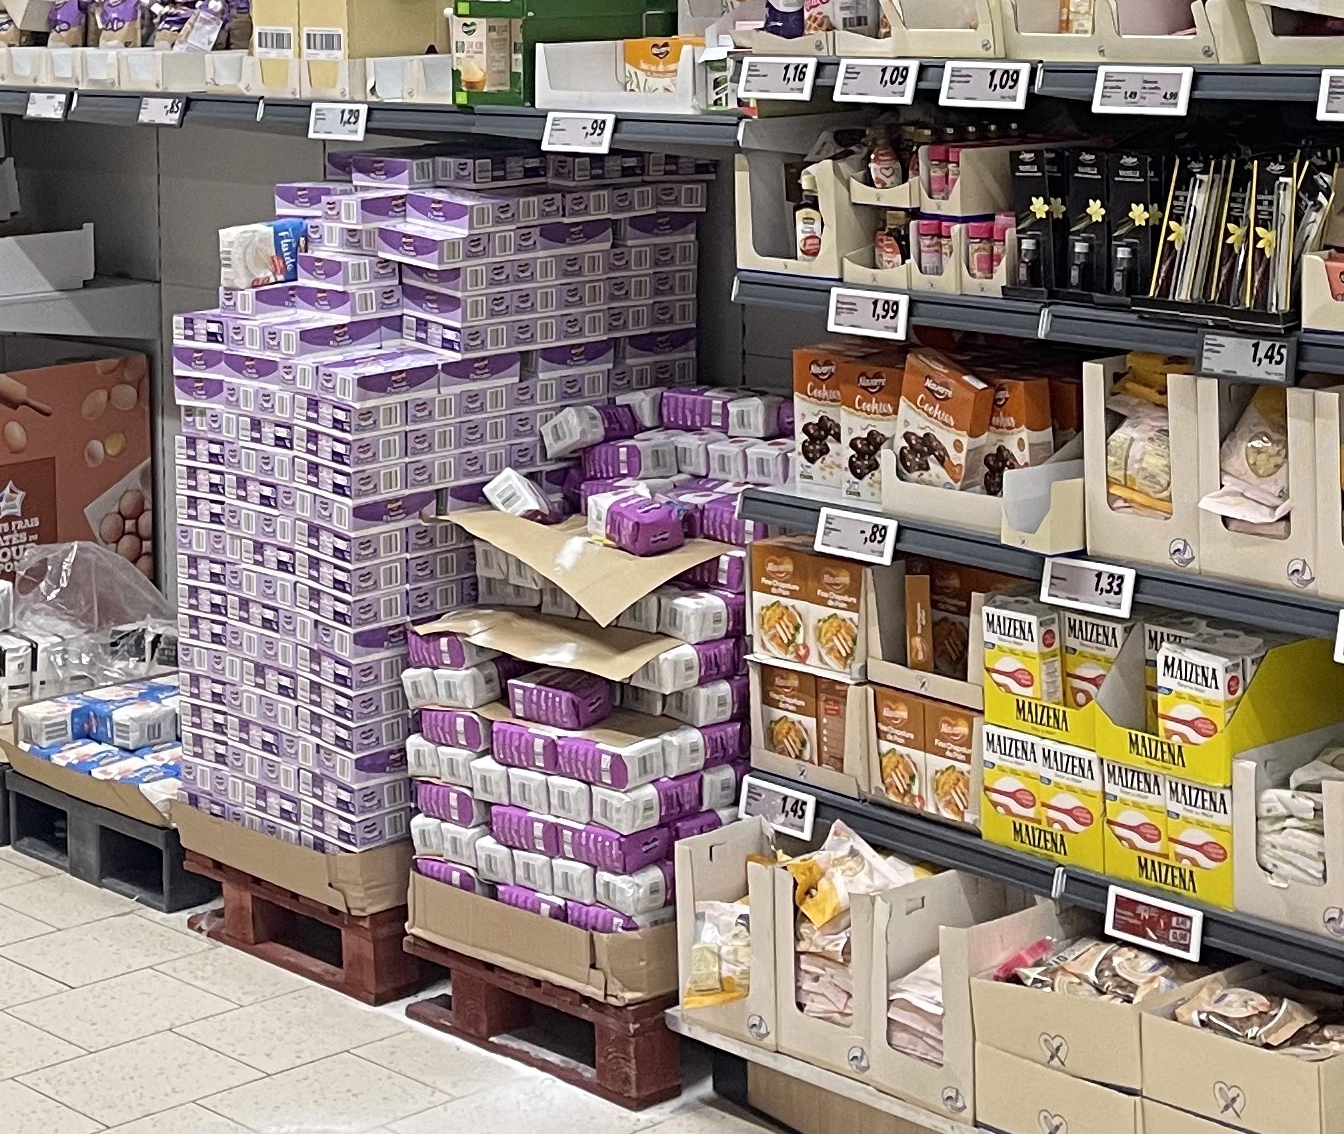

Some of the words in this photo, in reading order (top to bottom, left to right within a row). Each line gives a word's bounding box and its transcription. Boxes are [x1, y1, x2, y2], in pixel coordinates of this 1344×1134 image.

[783, 63, 806, 85] 1,16
[879, 65, 908, 87] 1,09
[988, 69, 1020, 92] 1,09
[339, 109, 361, 128] 1,29
[581, 118, 607, 139] -,99
[871, 298, 899, 321] 1,99
[1251, 340, 1287, 366] 1,45
[859, 523, 887, 544] -,89
[1093, 571, 1125, 596] 1,33
[985, 612, 1035, 643] MAIZENA
[1067, 616, 1119, 649] MAIZENA
[1162, 655, 1220, 690] MAIZENA
[1015, 698, 1069, 733] MAIZENA
[985, 731, 1038, 764] MAIZENA
[1128, 731, 1186, 768] MAIZENA
[1042, 746, 1095, 782] MAIZENA
[1106, 760, 1162, 797] MAIZENA
[780, 794, 807, 820] 1,45
[1167, 779, 1228, 815] MAIZENA
[1012, 821, 1068, 857] MAIZENA
[1137, 855, 1197, 894] MAIZENA
